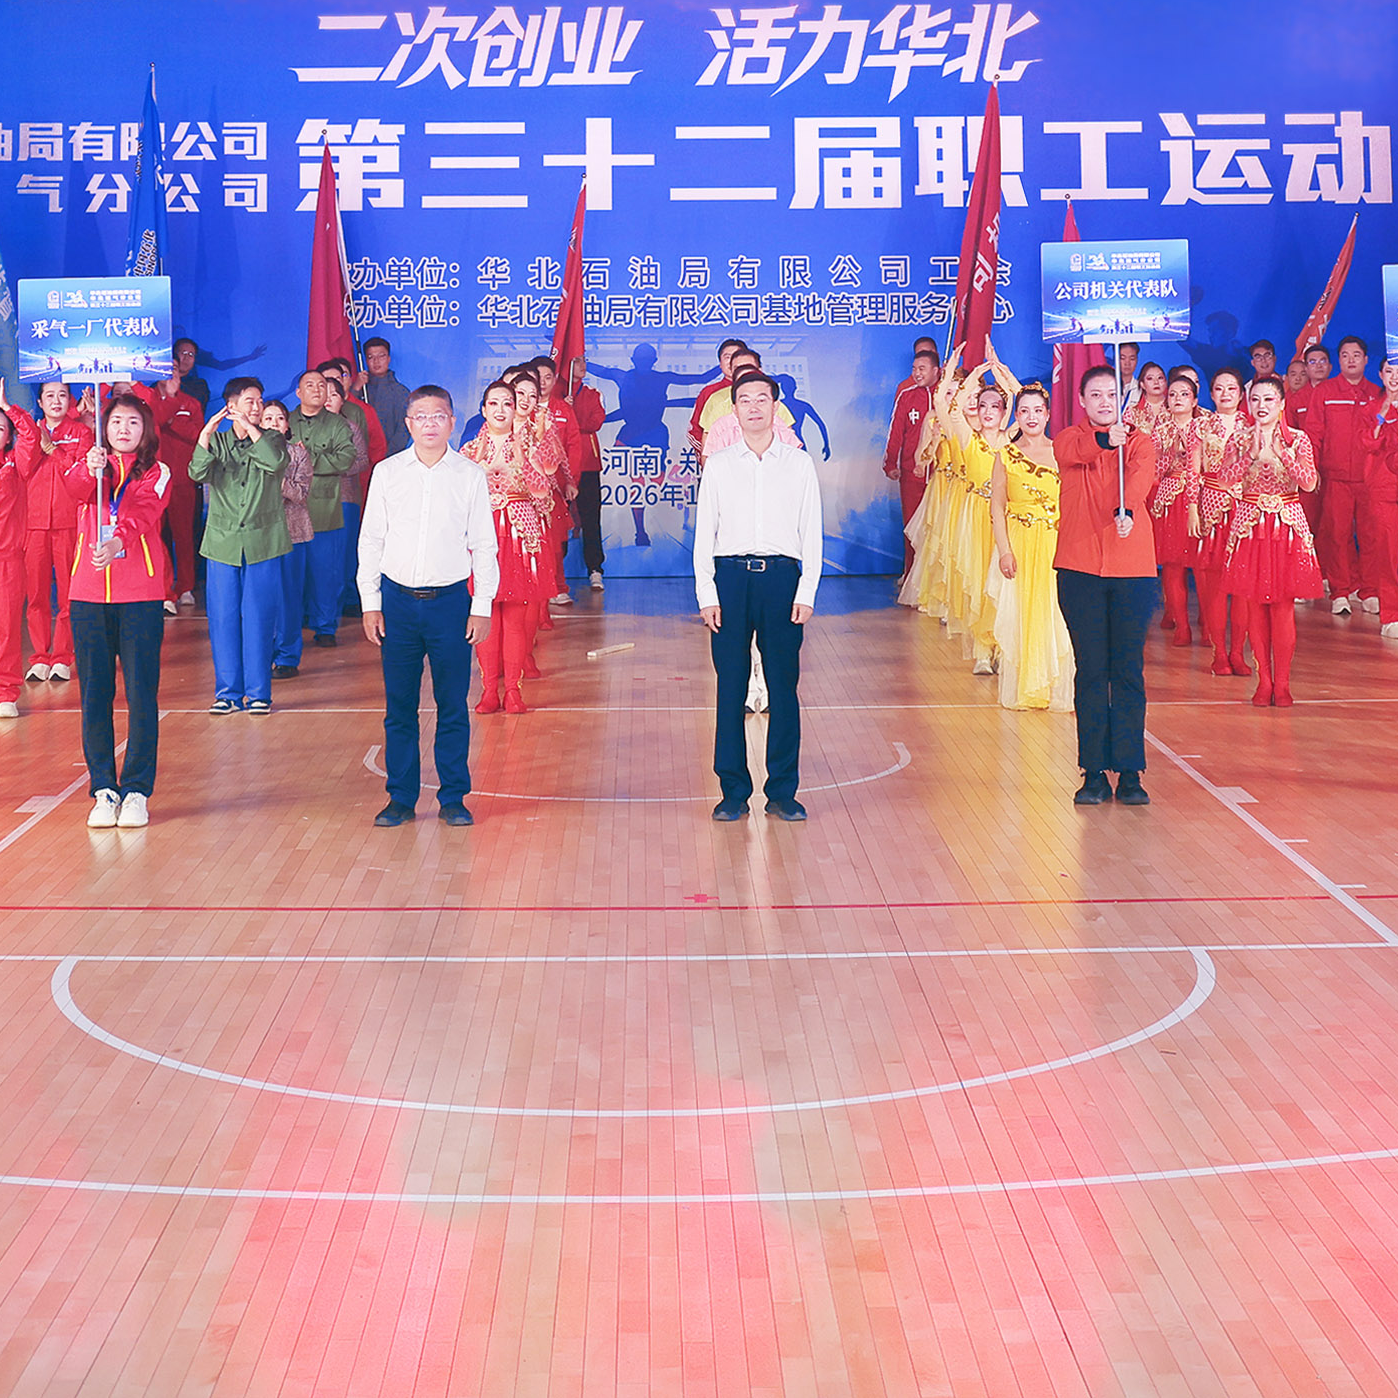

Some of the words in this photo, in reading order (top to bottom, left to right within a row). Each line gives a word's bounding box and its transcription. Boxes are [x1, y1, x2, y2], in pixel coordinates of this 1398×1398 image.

[287, 4, 645, 90] 二次创业
[695, 1, 1044, 103] 活力华北
[1054, 279, 1177, 300] 公司机关代表队
[31, 317, 159, 339] 采气一厂代表队
